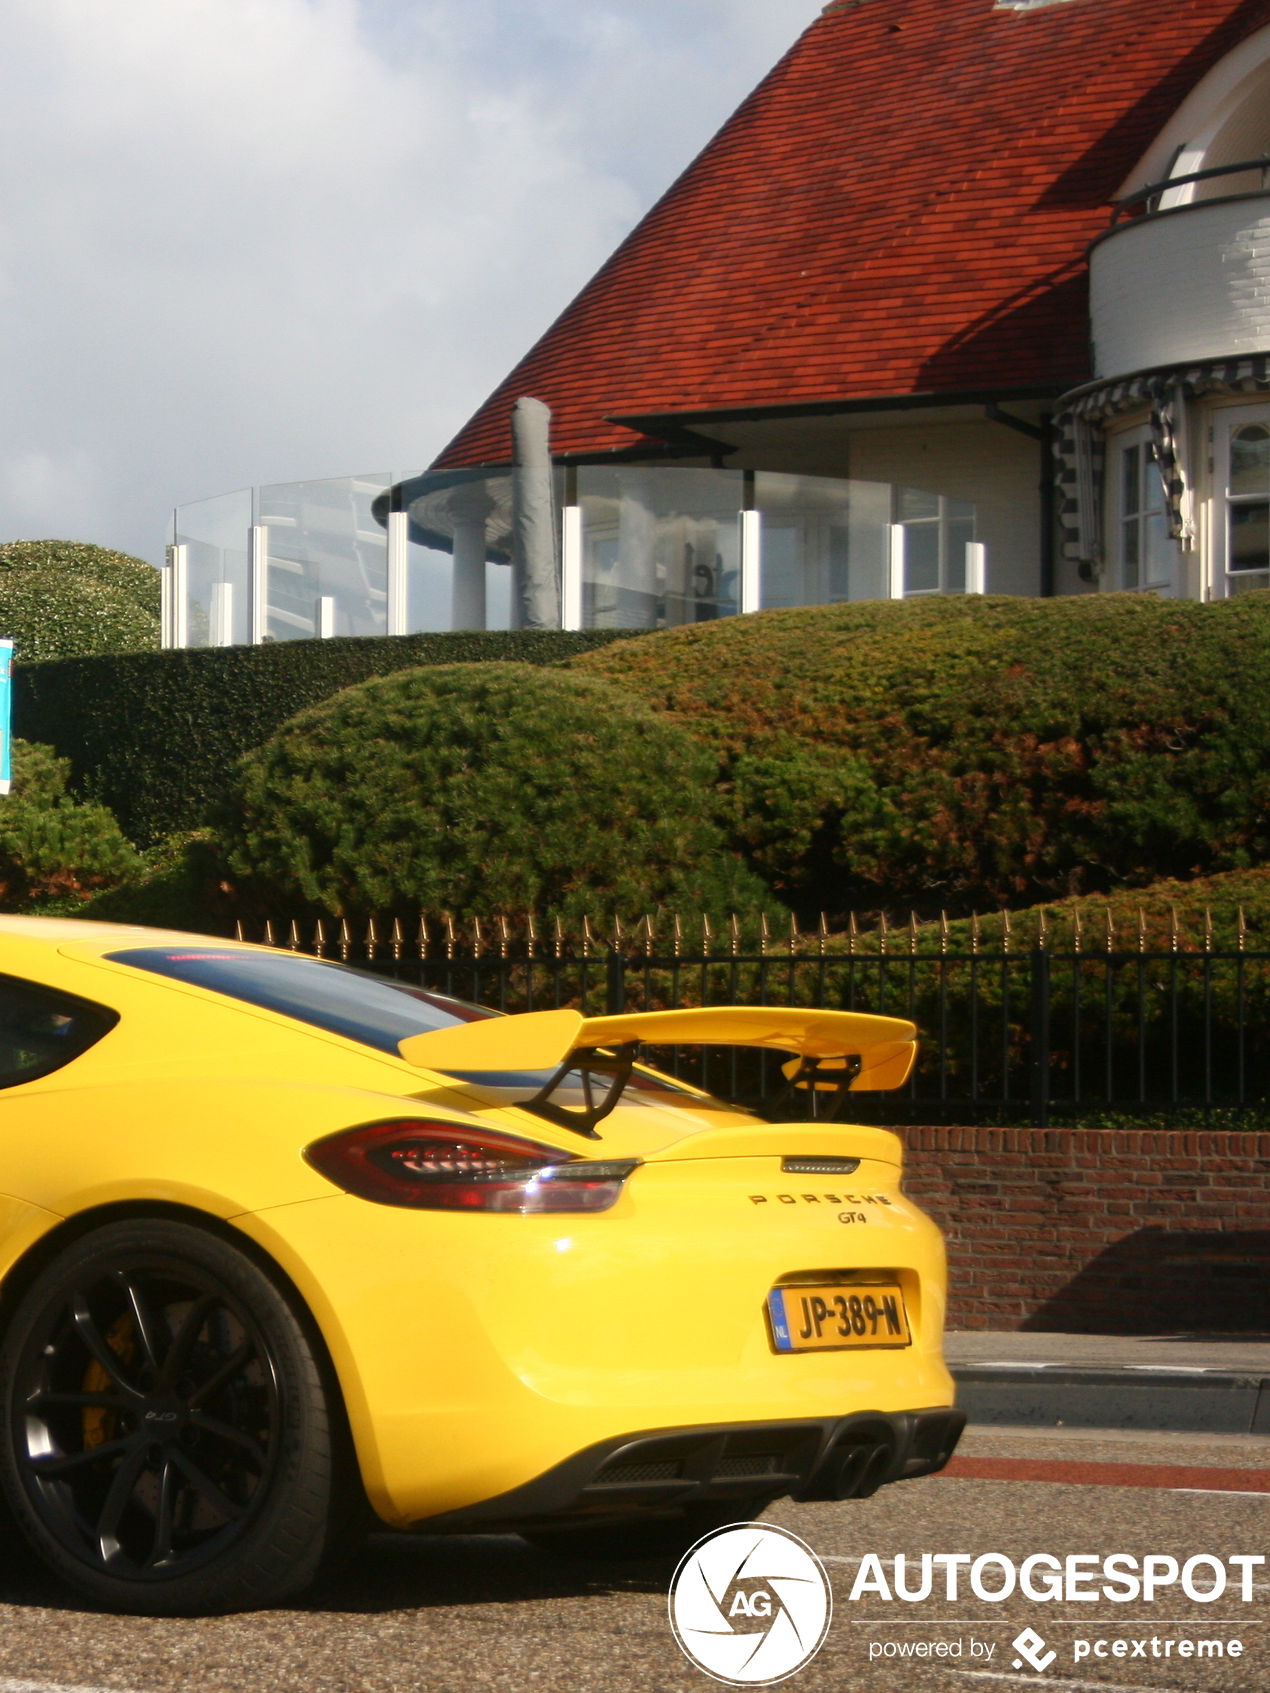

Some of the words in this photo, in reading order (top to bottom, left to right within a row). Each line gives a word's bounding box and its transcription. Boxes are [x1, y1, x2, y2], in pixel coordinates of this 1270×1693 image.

[747, 1194, 892, 1206] PORSCHE
[837, 1212, 867, 1224] GT4
[800, 1295, 901, 1339] JP-389-N
[776, 1326, 788, 1338] NL
